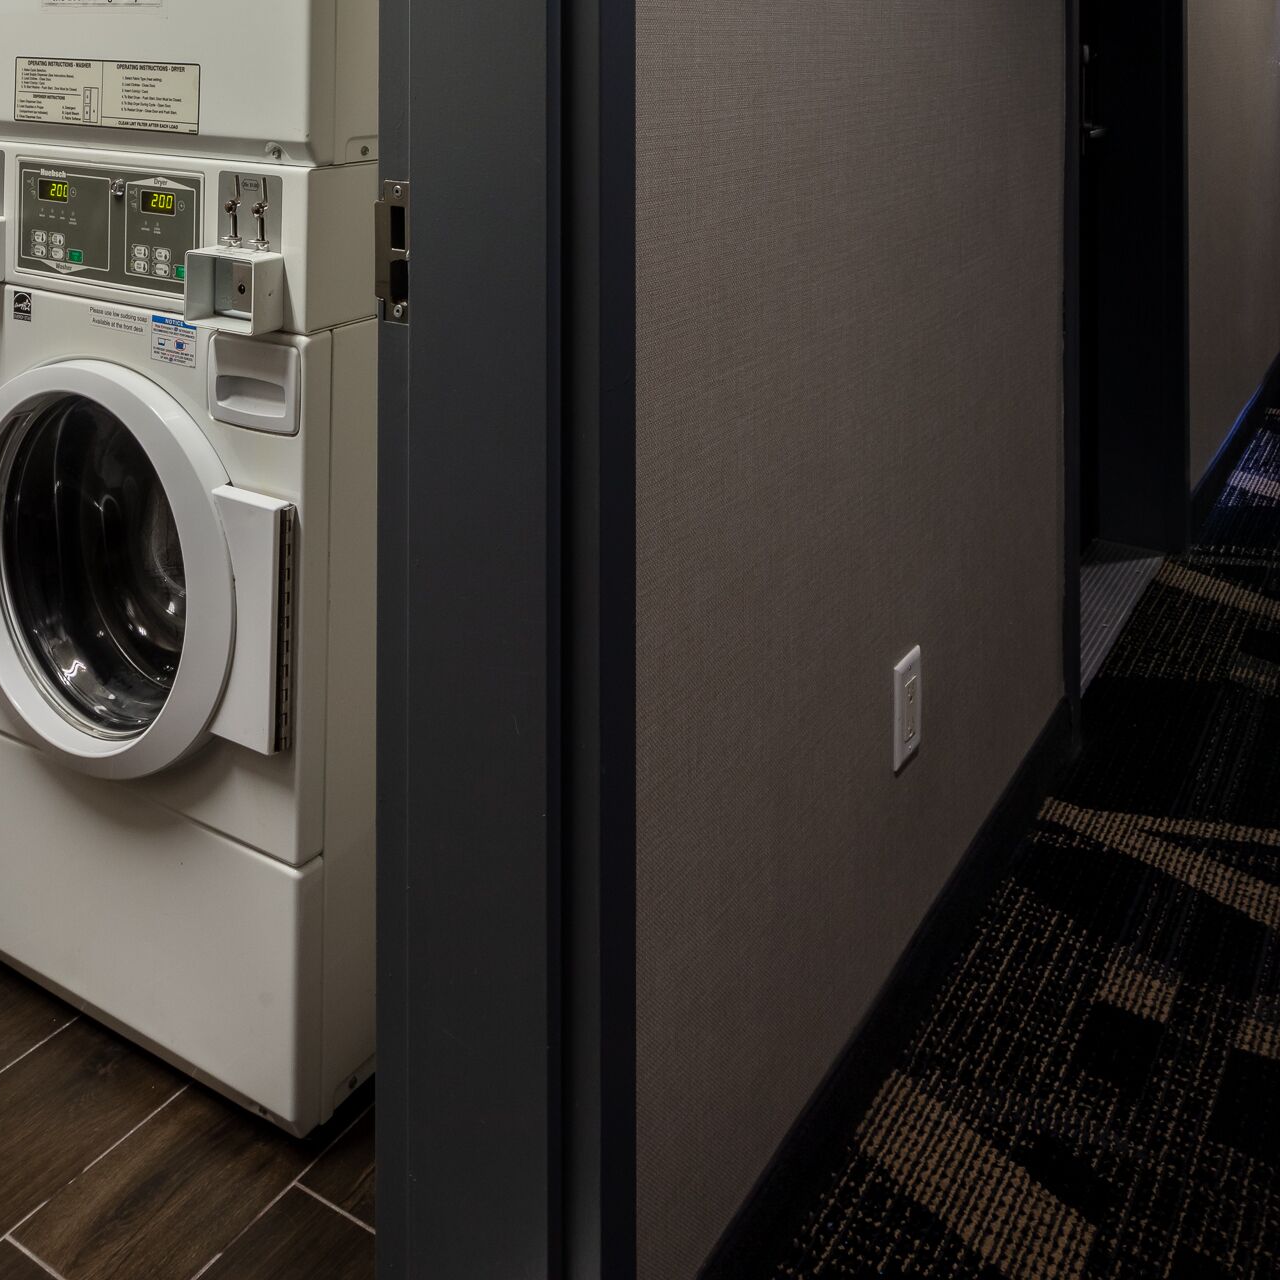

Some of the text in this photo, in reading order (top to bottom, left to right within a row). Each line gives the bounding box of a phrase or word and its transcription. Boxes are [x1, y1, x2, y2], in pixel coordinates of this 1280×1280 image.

[40, 169, 66, 178] Huebsch
[154, 178, 168, 187] Dryer
[151, 194, 173, 209] 200
[55, 262, 72, 271] Washer
[92, 318, 110, 326] Available
